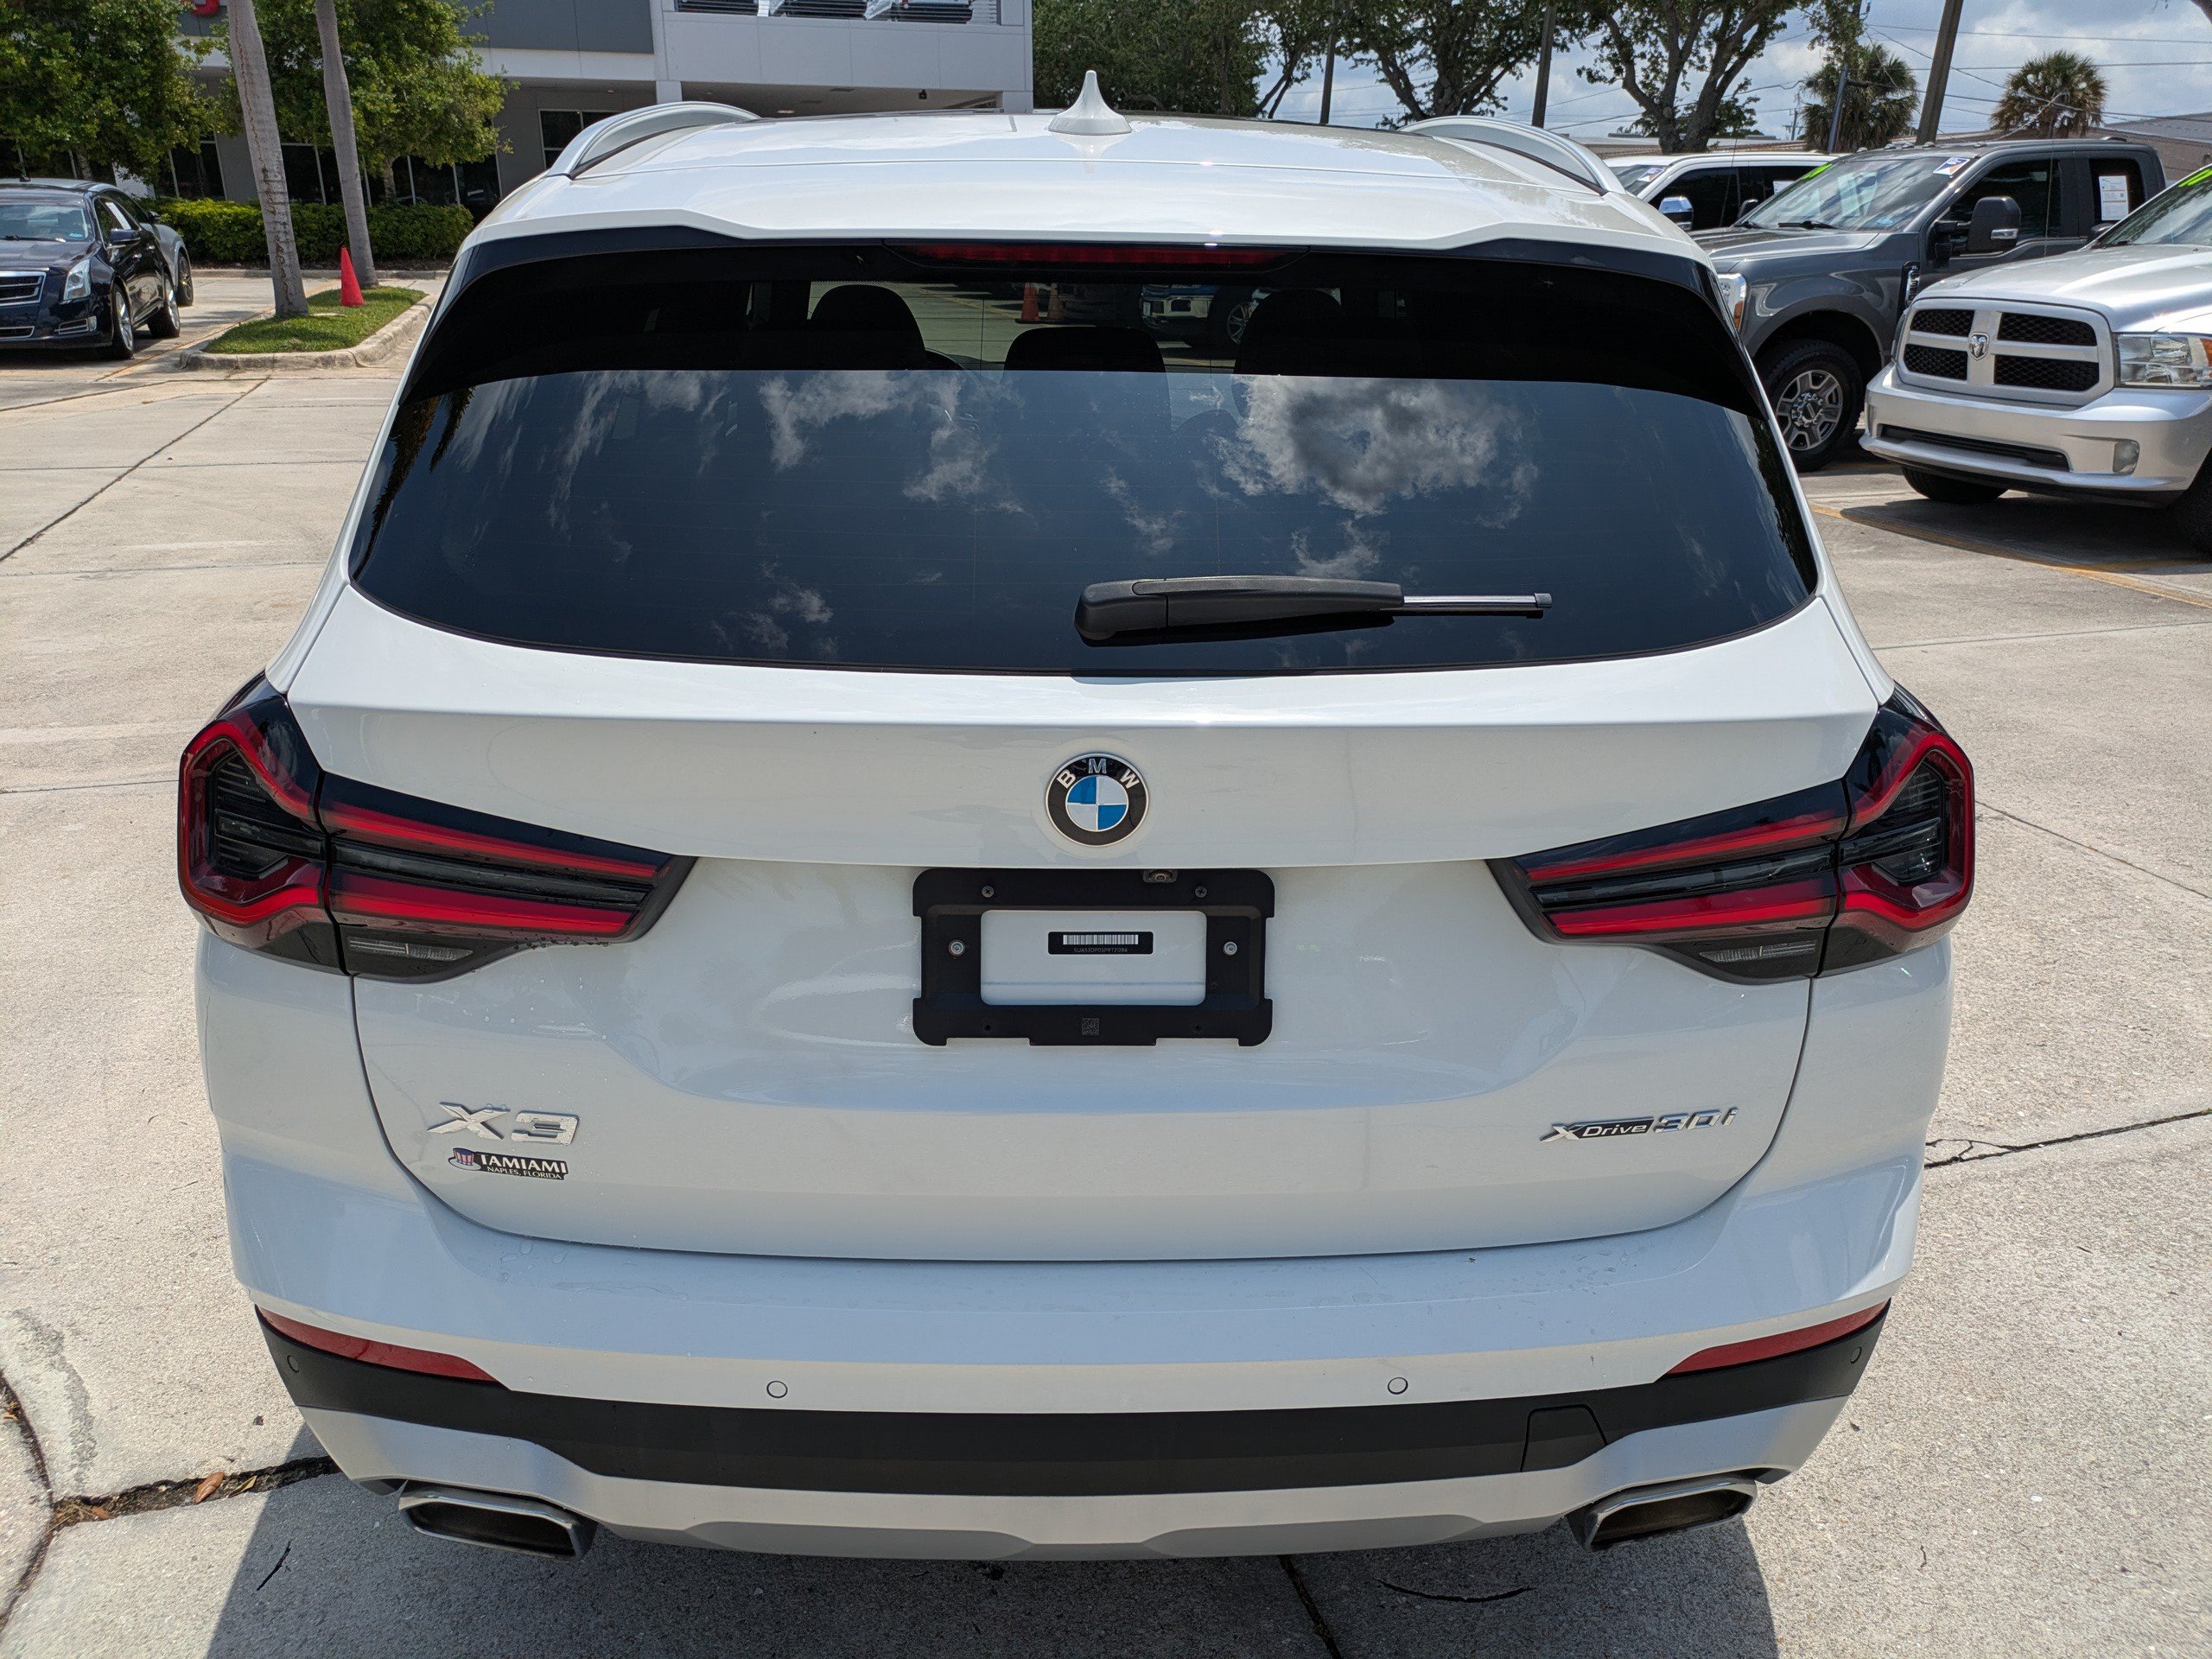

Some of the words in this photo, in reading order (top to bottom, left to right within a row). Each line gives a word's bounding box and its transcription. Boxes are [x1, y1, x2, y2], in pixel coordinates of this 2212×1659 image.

[1056, 758, 1141, 789] BMW
[426, 1101, 580, 1146] X3
[523, 1170, 563, 1180] FLORIDA
